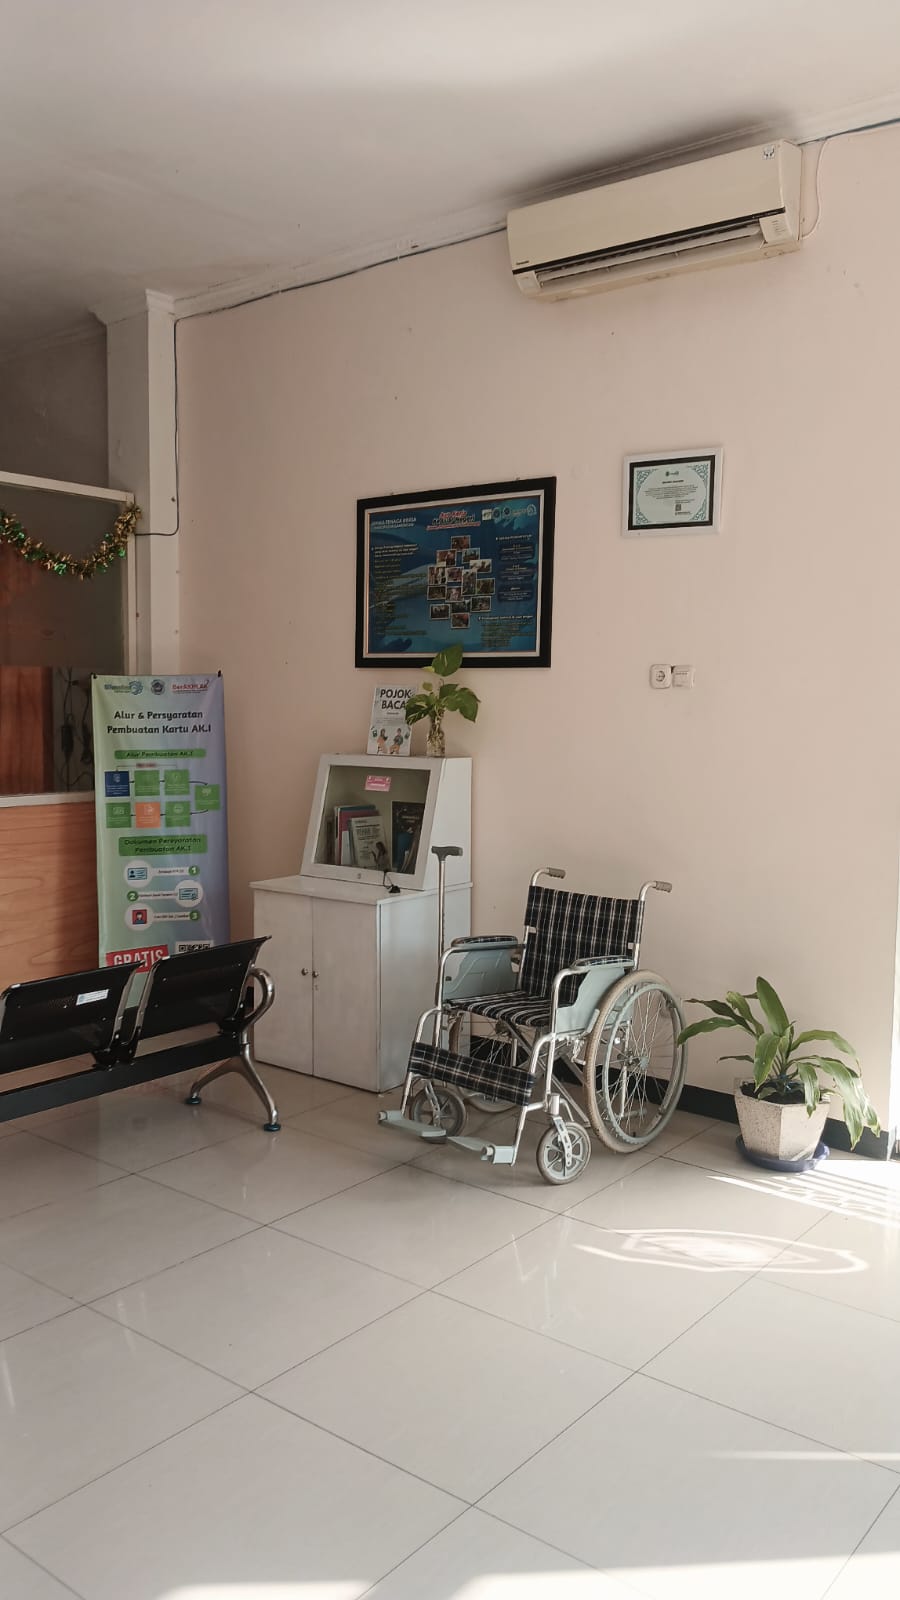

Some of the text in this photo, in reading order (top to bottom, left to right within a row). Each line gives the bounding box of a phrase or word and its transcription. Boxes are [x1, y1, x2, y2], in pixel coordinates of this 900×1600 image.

[380, 689, 411, 698] POJOK
[381, 700, 406, 709] BACA
[114, 711, 203, 721] Alur & Persyaratan
[107, 725, 160, 734] Pembuatan
[162, 725, 189, 734] Kartu
[113, 949, 164, 967] GRATIS
